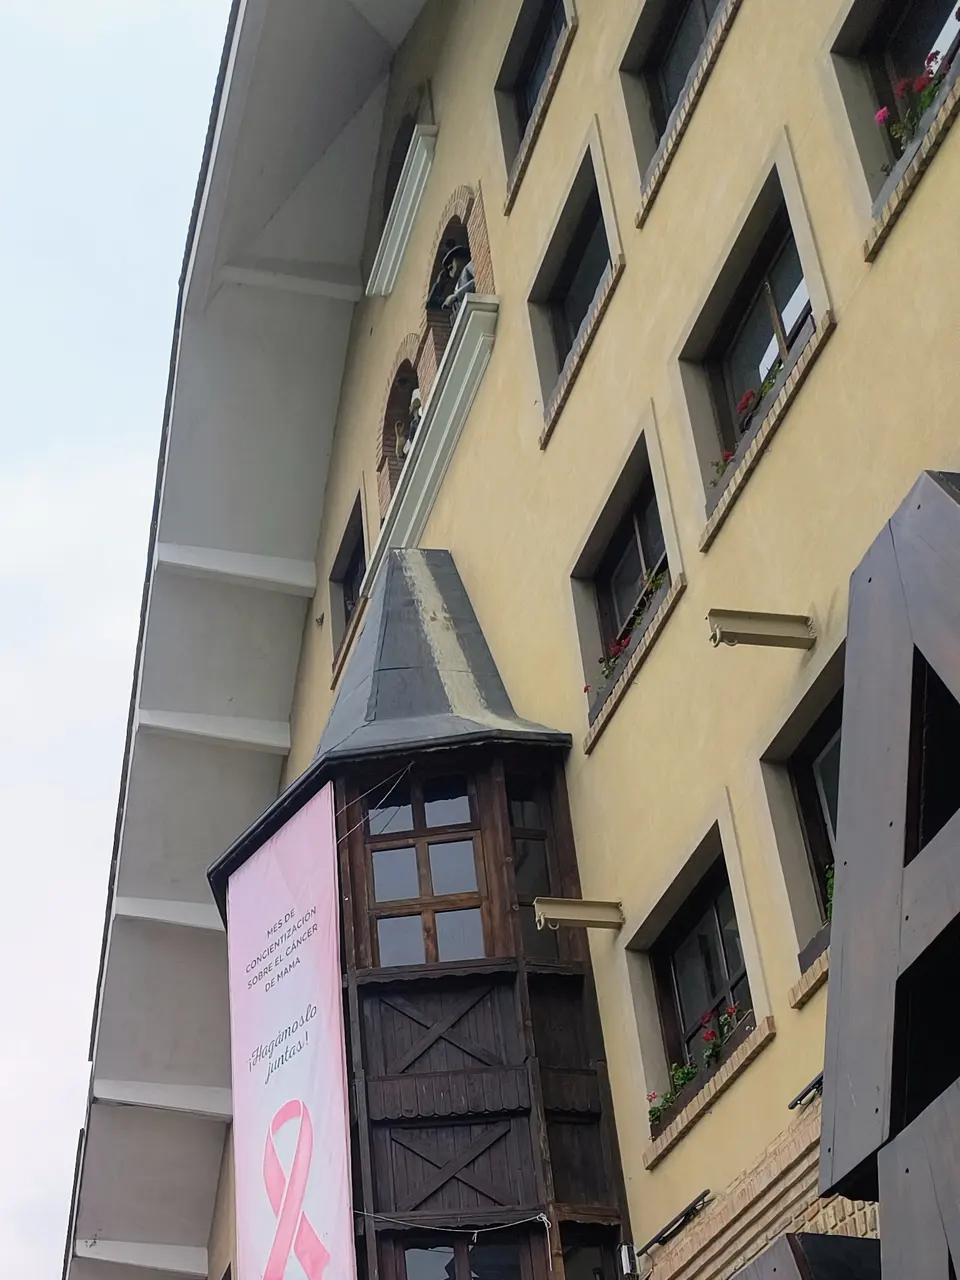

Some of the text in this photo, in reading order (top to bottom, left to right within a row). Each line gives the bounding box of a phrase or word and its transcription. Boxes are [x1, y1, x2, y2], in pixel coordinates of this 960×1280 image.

[245, 905, 317, 974] CONCIENTIZACIÓN
[266, 907, 296, 939] MES DE
[247, 923, 318, 990] SOBRE EL CÁNCER
[264, 956, 301, 993] DE MAMA
[247, 1003, 317, 1072] ¡Hagámoslo
[265, 1031, 309, 1085] juntas!
